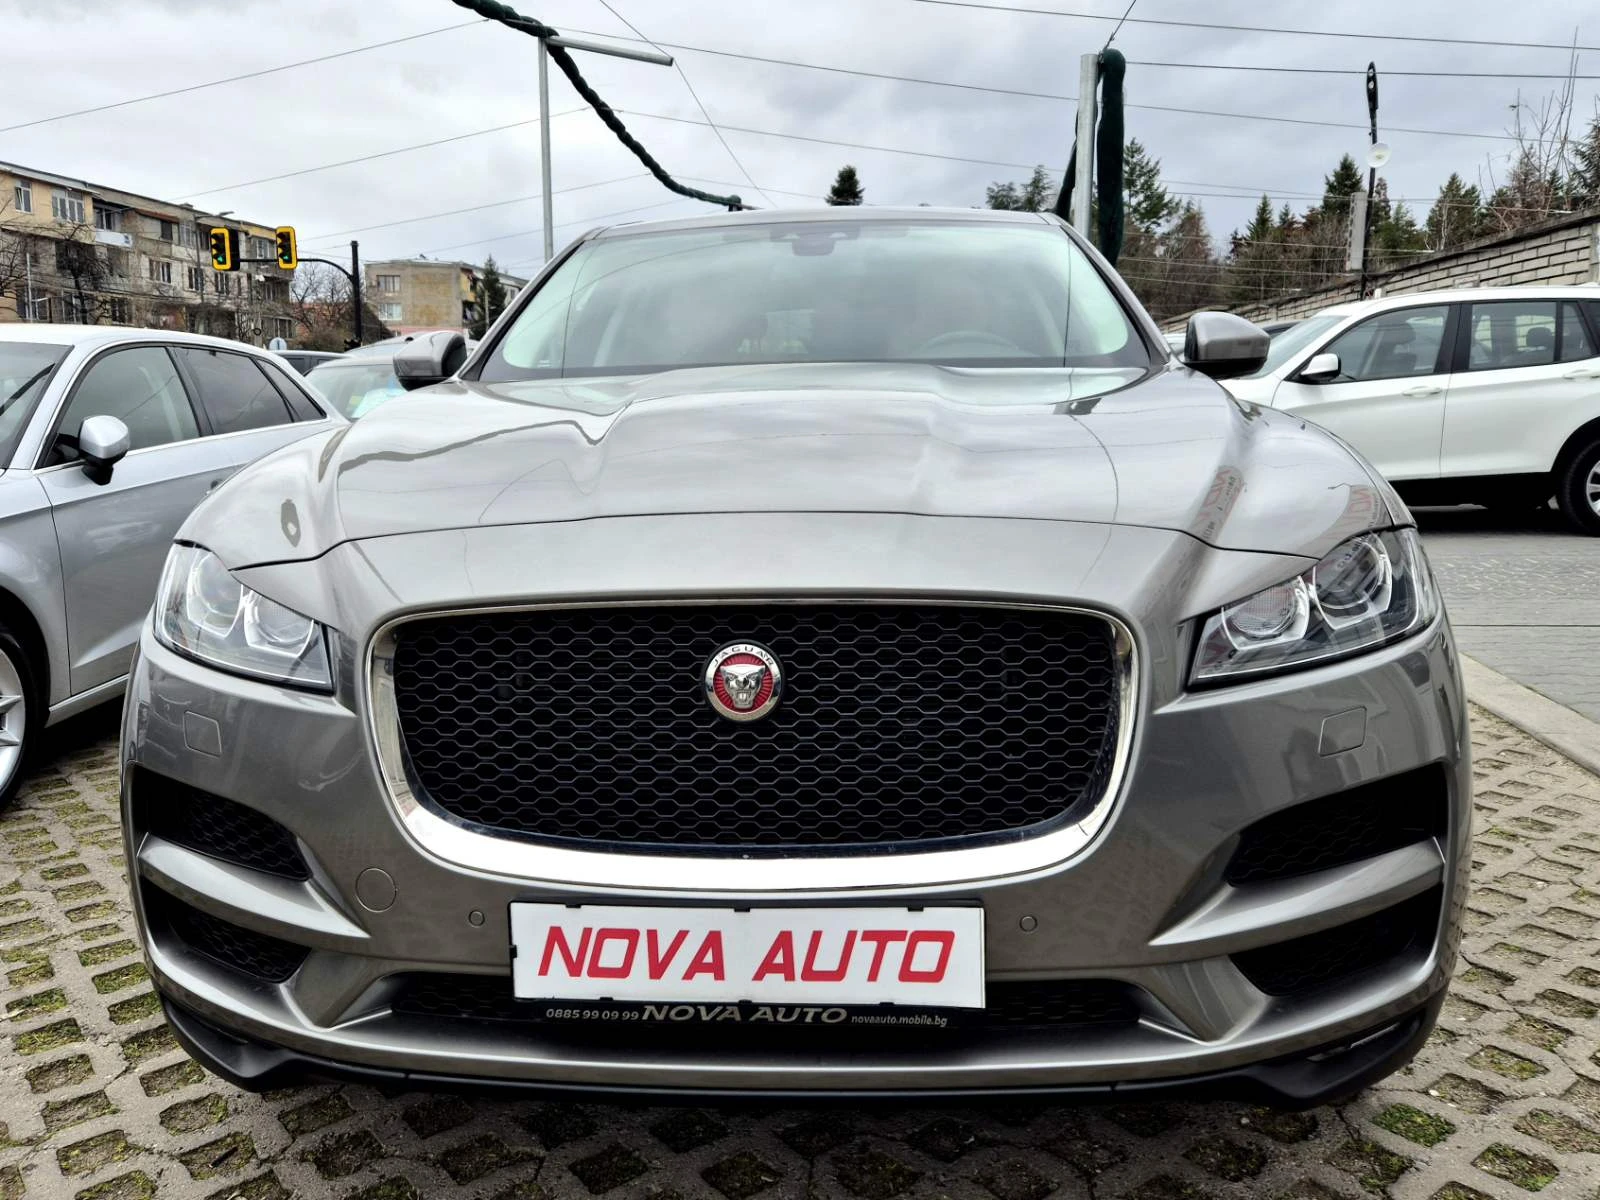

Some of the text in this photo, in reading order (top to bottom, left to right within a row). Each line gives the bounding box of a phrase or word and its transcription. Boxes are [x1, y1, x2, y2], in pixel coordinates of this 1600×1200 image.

[714, 646, 774, 668] JAGUAR
[538, 926, 955, 983] NOVA AUTO
[545, 1005, 949, 1028] 0885 99 09 99 NOVA AUTO novaauto.mobile.bg
